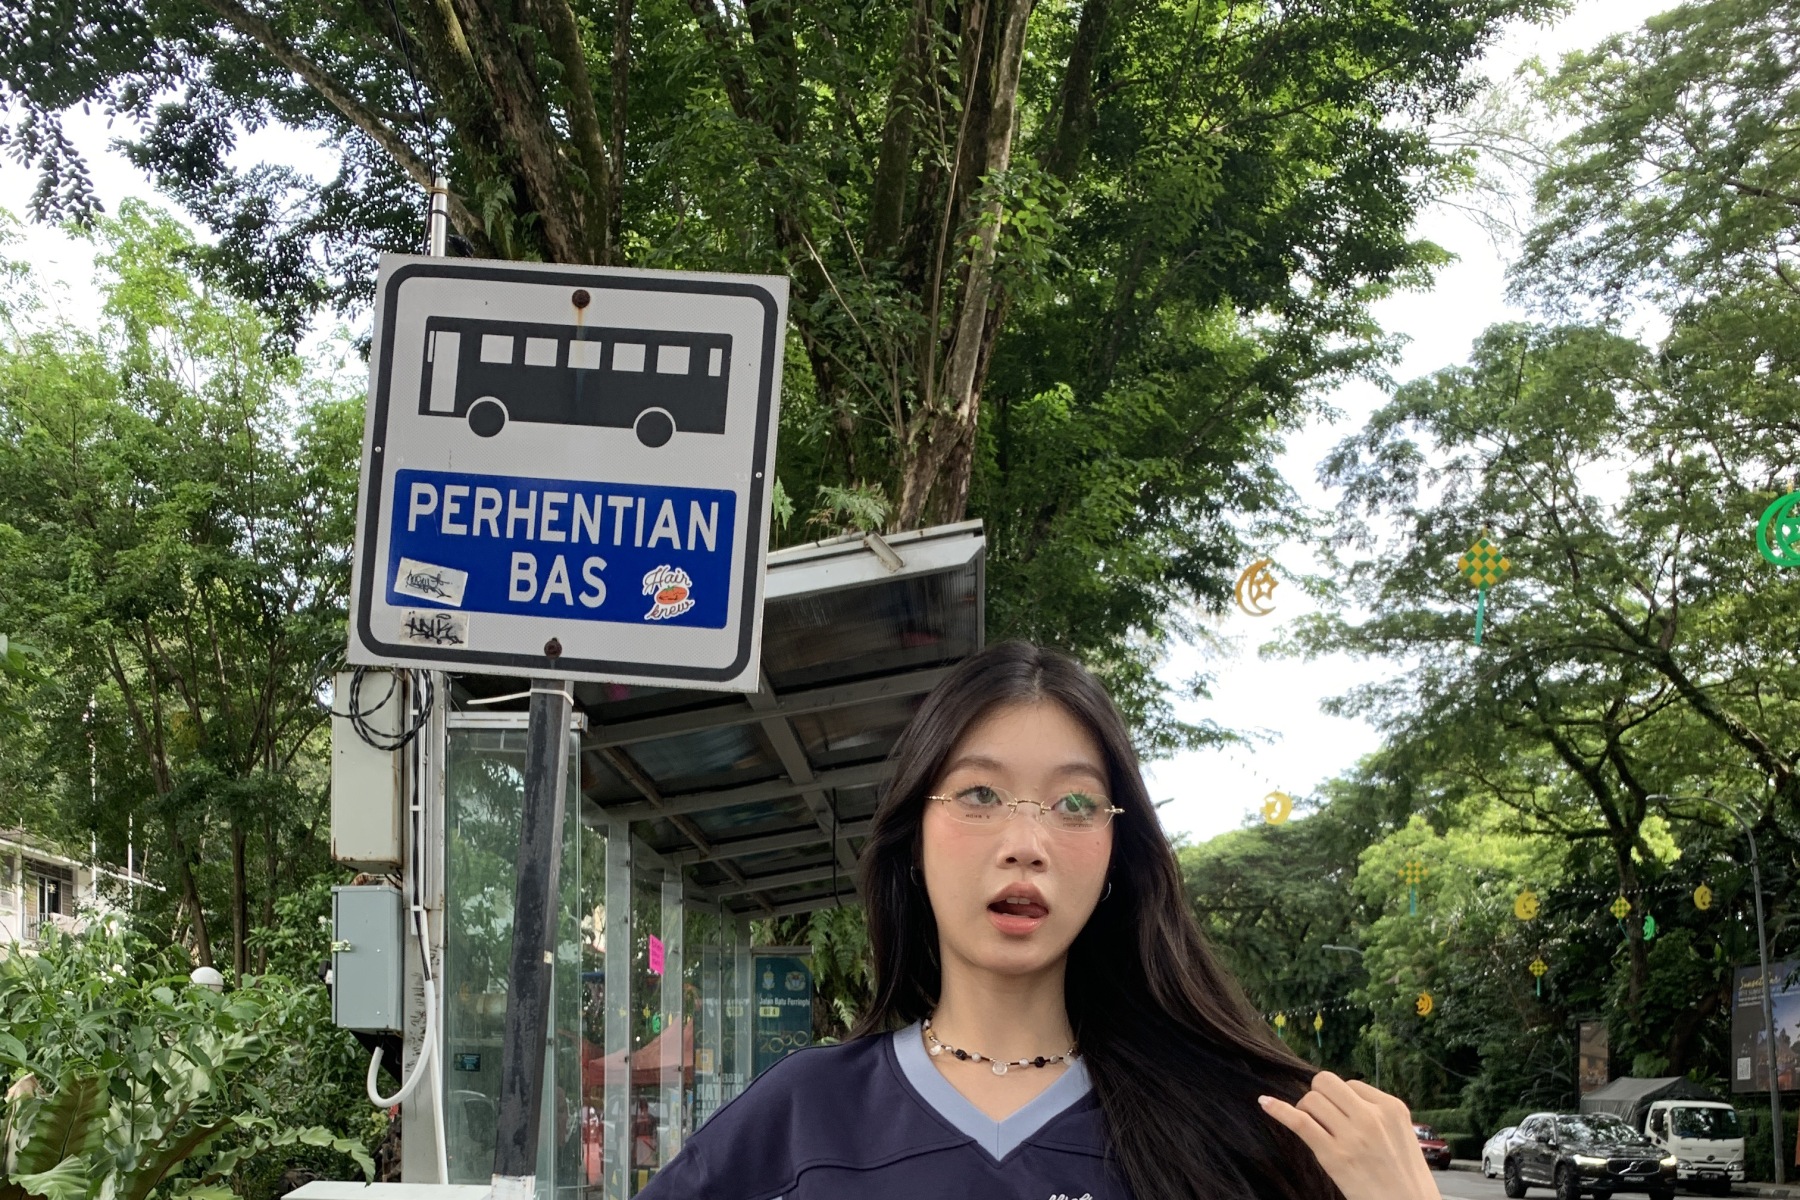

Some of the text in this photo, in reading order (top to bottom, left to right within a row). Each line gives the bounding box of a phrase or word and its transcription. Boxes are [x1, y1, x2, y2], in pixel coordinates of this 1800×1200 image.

[407, 482, 719, 552] PERHENTIAN
[509, 551, 608, 608] BAS
[643, 566, 691, 594] Hair
